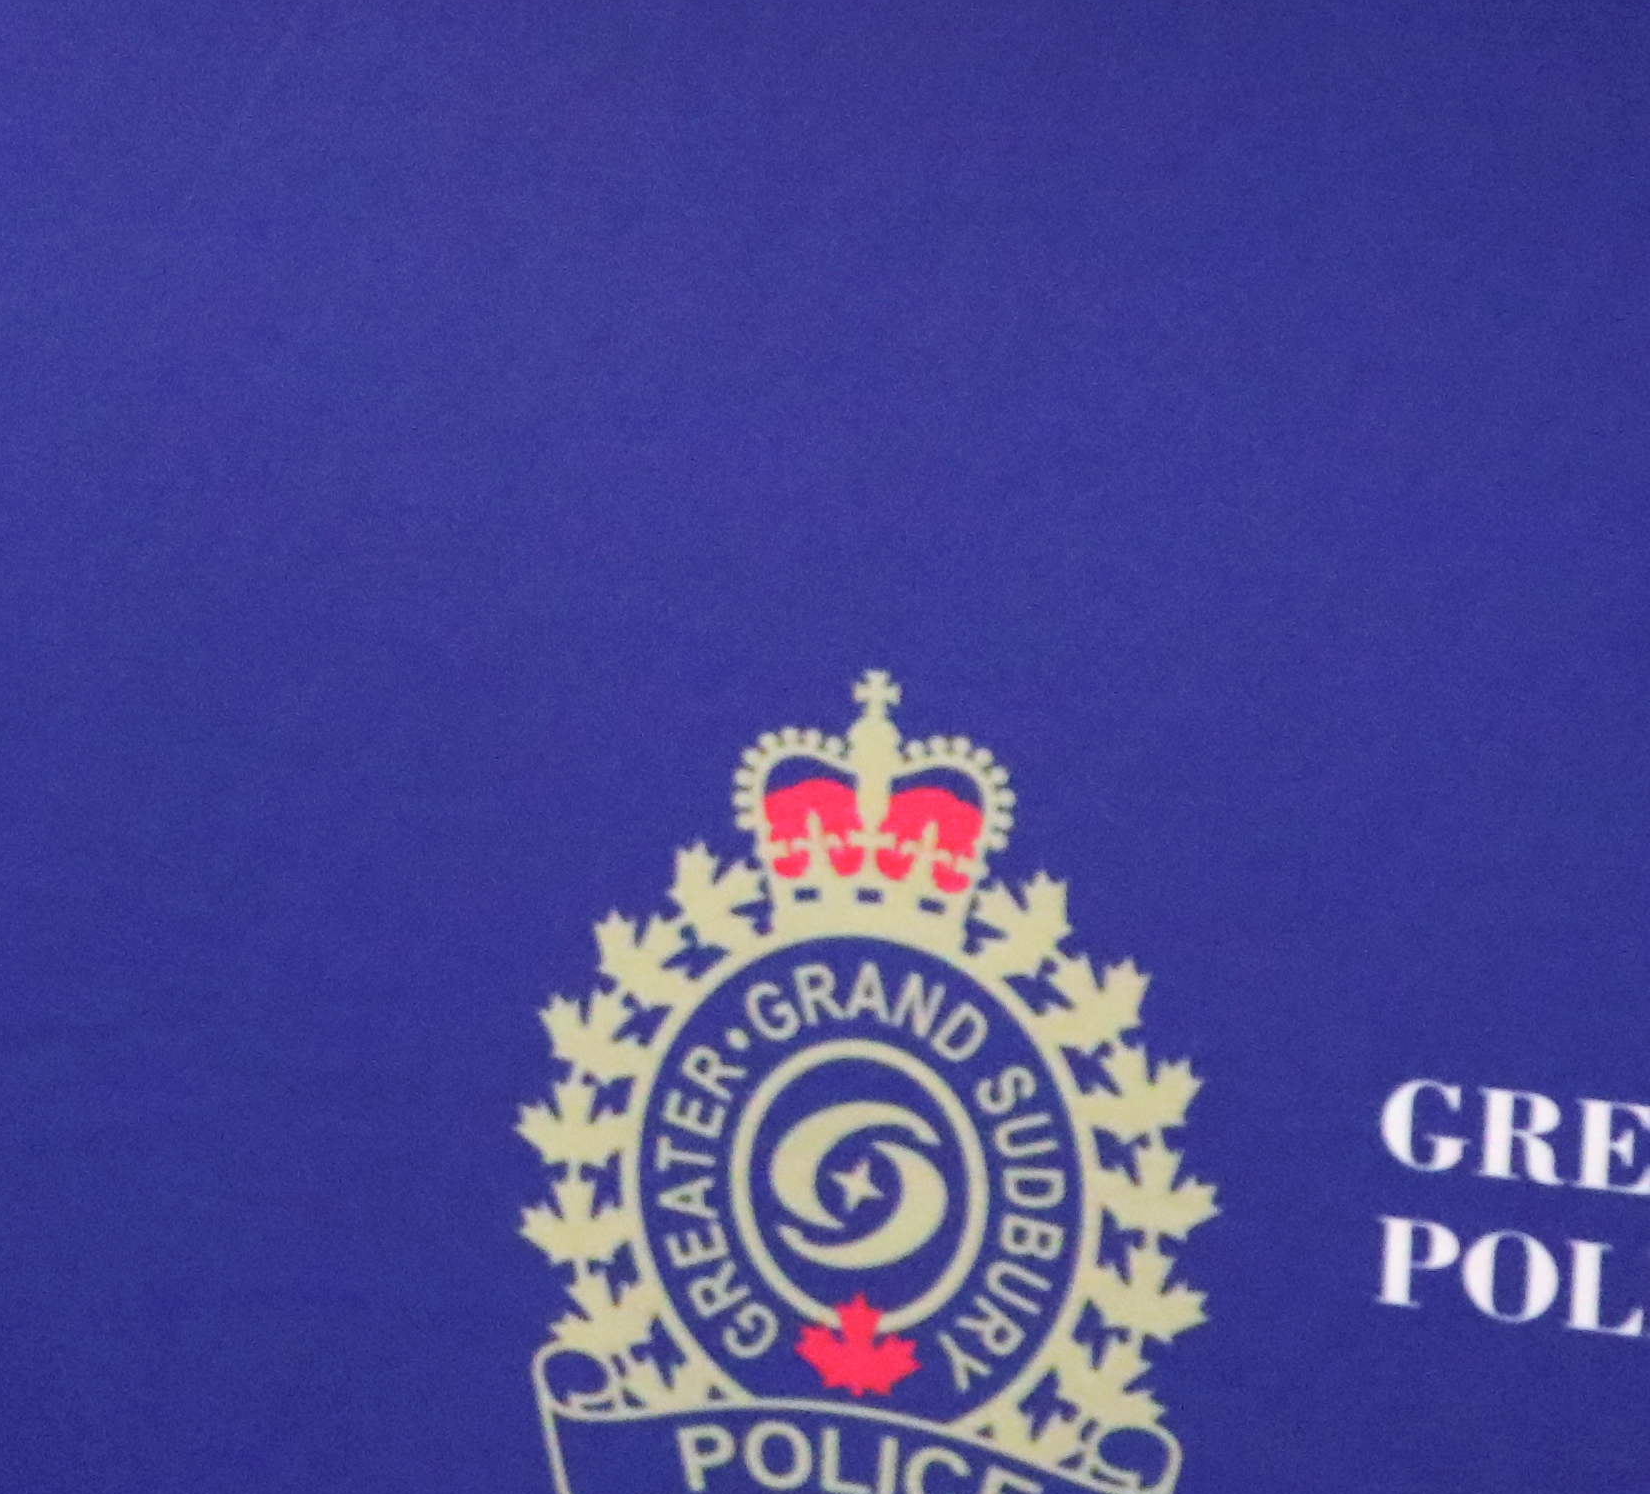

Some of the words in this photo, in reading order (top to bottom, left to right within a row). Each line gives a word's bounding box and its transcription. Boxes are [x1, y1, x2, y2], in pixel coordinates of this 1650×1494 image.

[656, 1045, 778, 1358] GREATER
[745, 961, 989, 1064] GRAND
[936, 1065, 1066, 1392] SUDBURY
[1375, 1214, 1647, 1338] POL
